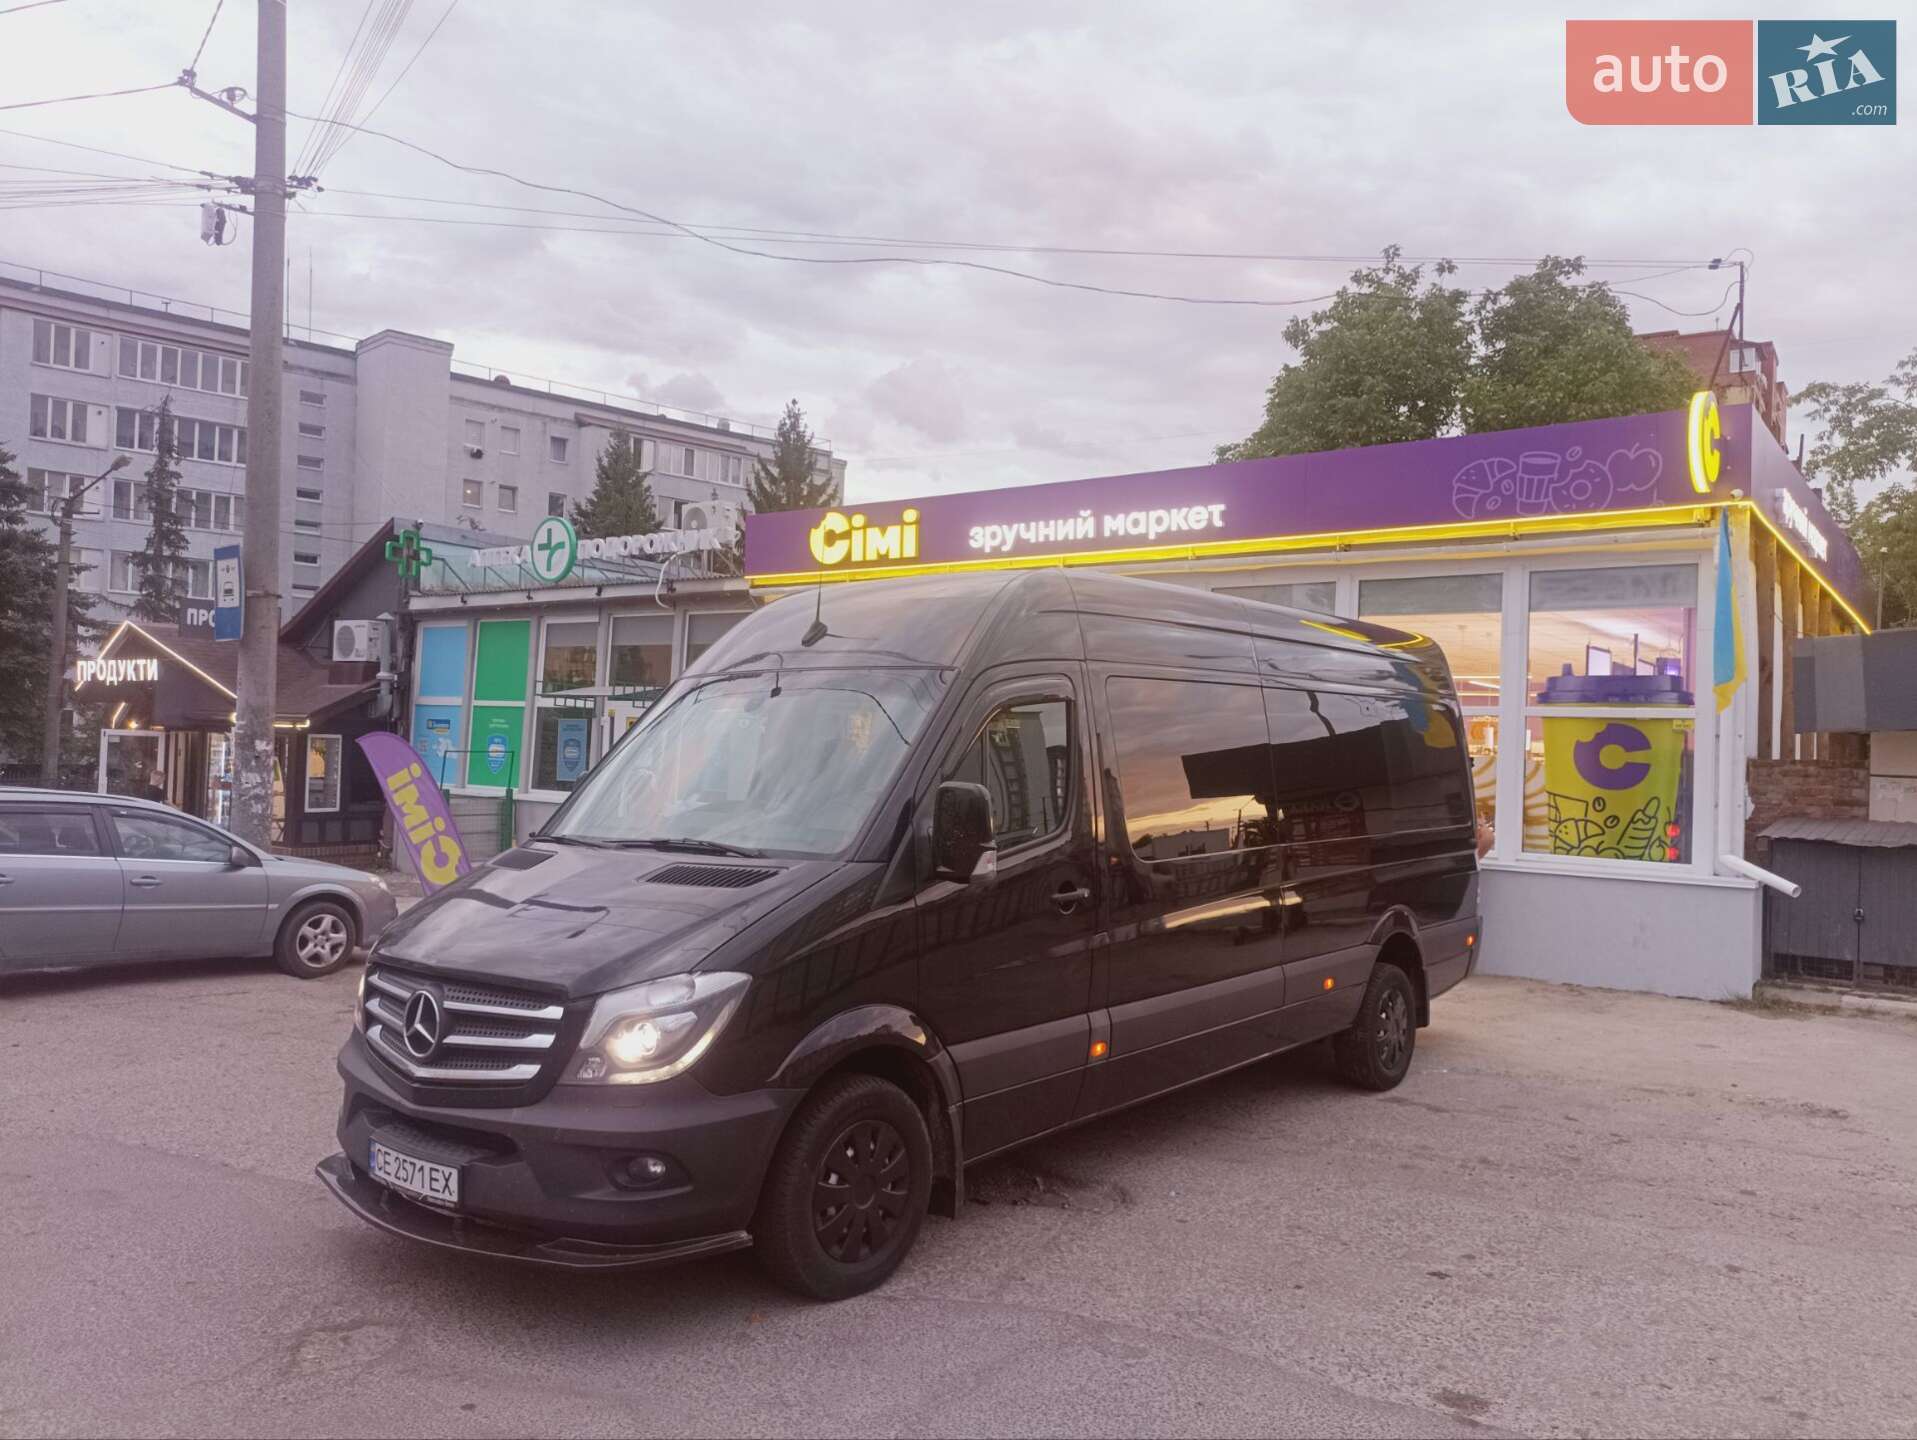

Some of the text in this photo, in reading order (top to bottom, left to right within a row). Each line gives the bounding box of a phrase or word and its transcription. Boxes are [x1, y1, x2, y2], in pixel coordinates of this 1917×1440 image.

[809, 503, 1226, 565] Сімі зручний маркет
[76, 658, 159, 686] ПРОДУКТИ
[394, 1156, 425, 1189] 2571
[429, 1166, 453, 1196] EX
